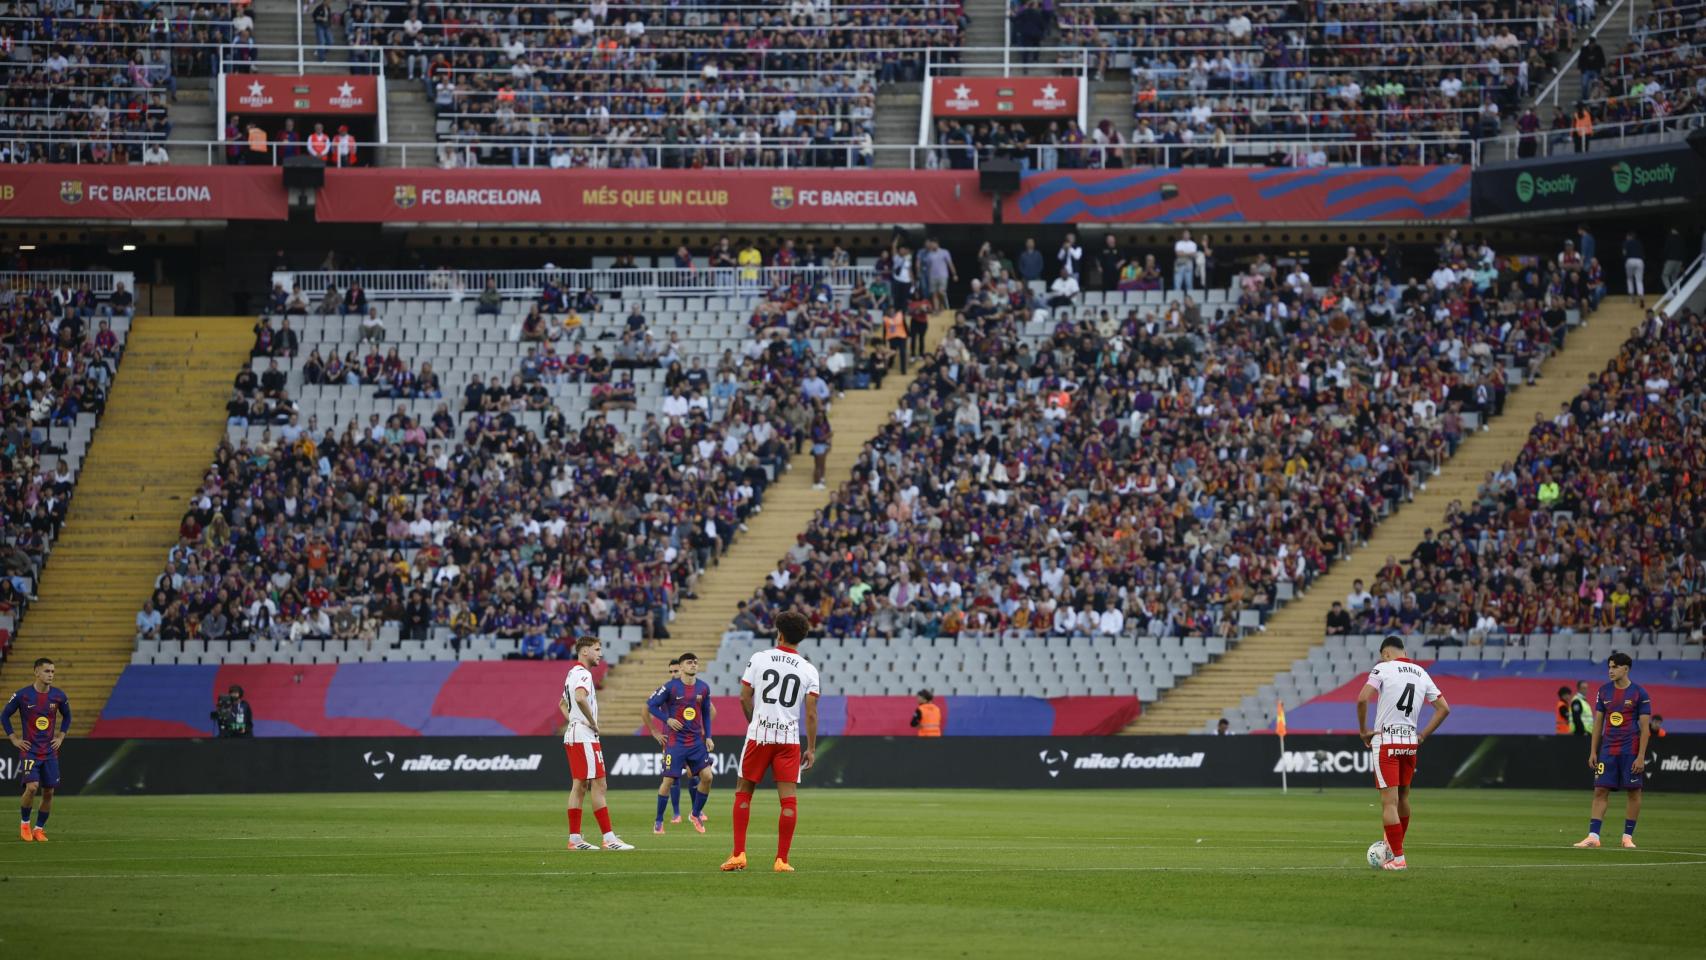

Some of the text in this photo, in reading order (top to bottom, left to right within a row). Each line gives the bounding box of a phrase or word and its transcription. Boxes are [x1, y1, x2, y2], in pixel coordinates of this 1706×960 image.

[1634, 163, 1677, 187] Spotify
[88, 186, 211, 201] FC BARCELONA
[1536, 174, 1577, 197] Spotify
[421, 189, 541, 205] FC BARCELONA
[582, 186, 729, 207] MÉS QUE UN CLUB
[798, 190, 918, 206] FC BARCELONA
[771, 655, 800, 669] WITSEL
[1397, 666, 1422, 678] ARNAU
[761, 668, 801, 708] 20
[1396, 682, 1415, 718] 4
[759, 719, 789, 731] Marlex
[24, 759, 35, 771] 17
[401, 754, 542, 771] nike football
[665, 754, 672, 766] 8
[1074, 752, 1205, 769] nike football
[1660, 755, 1690, 770] nike
